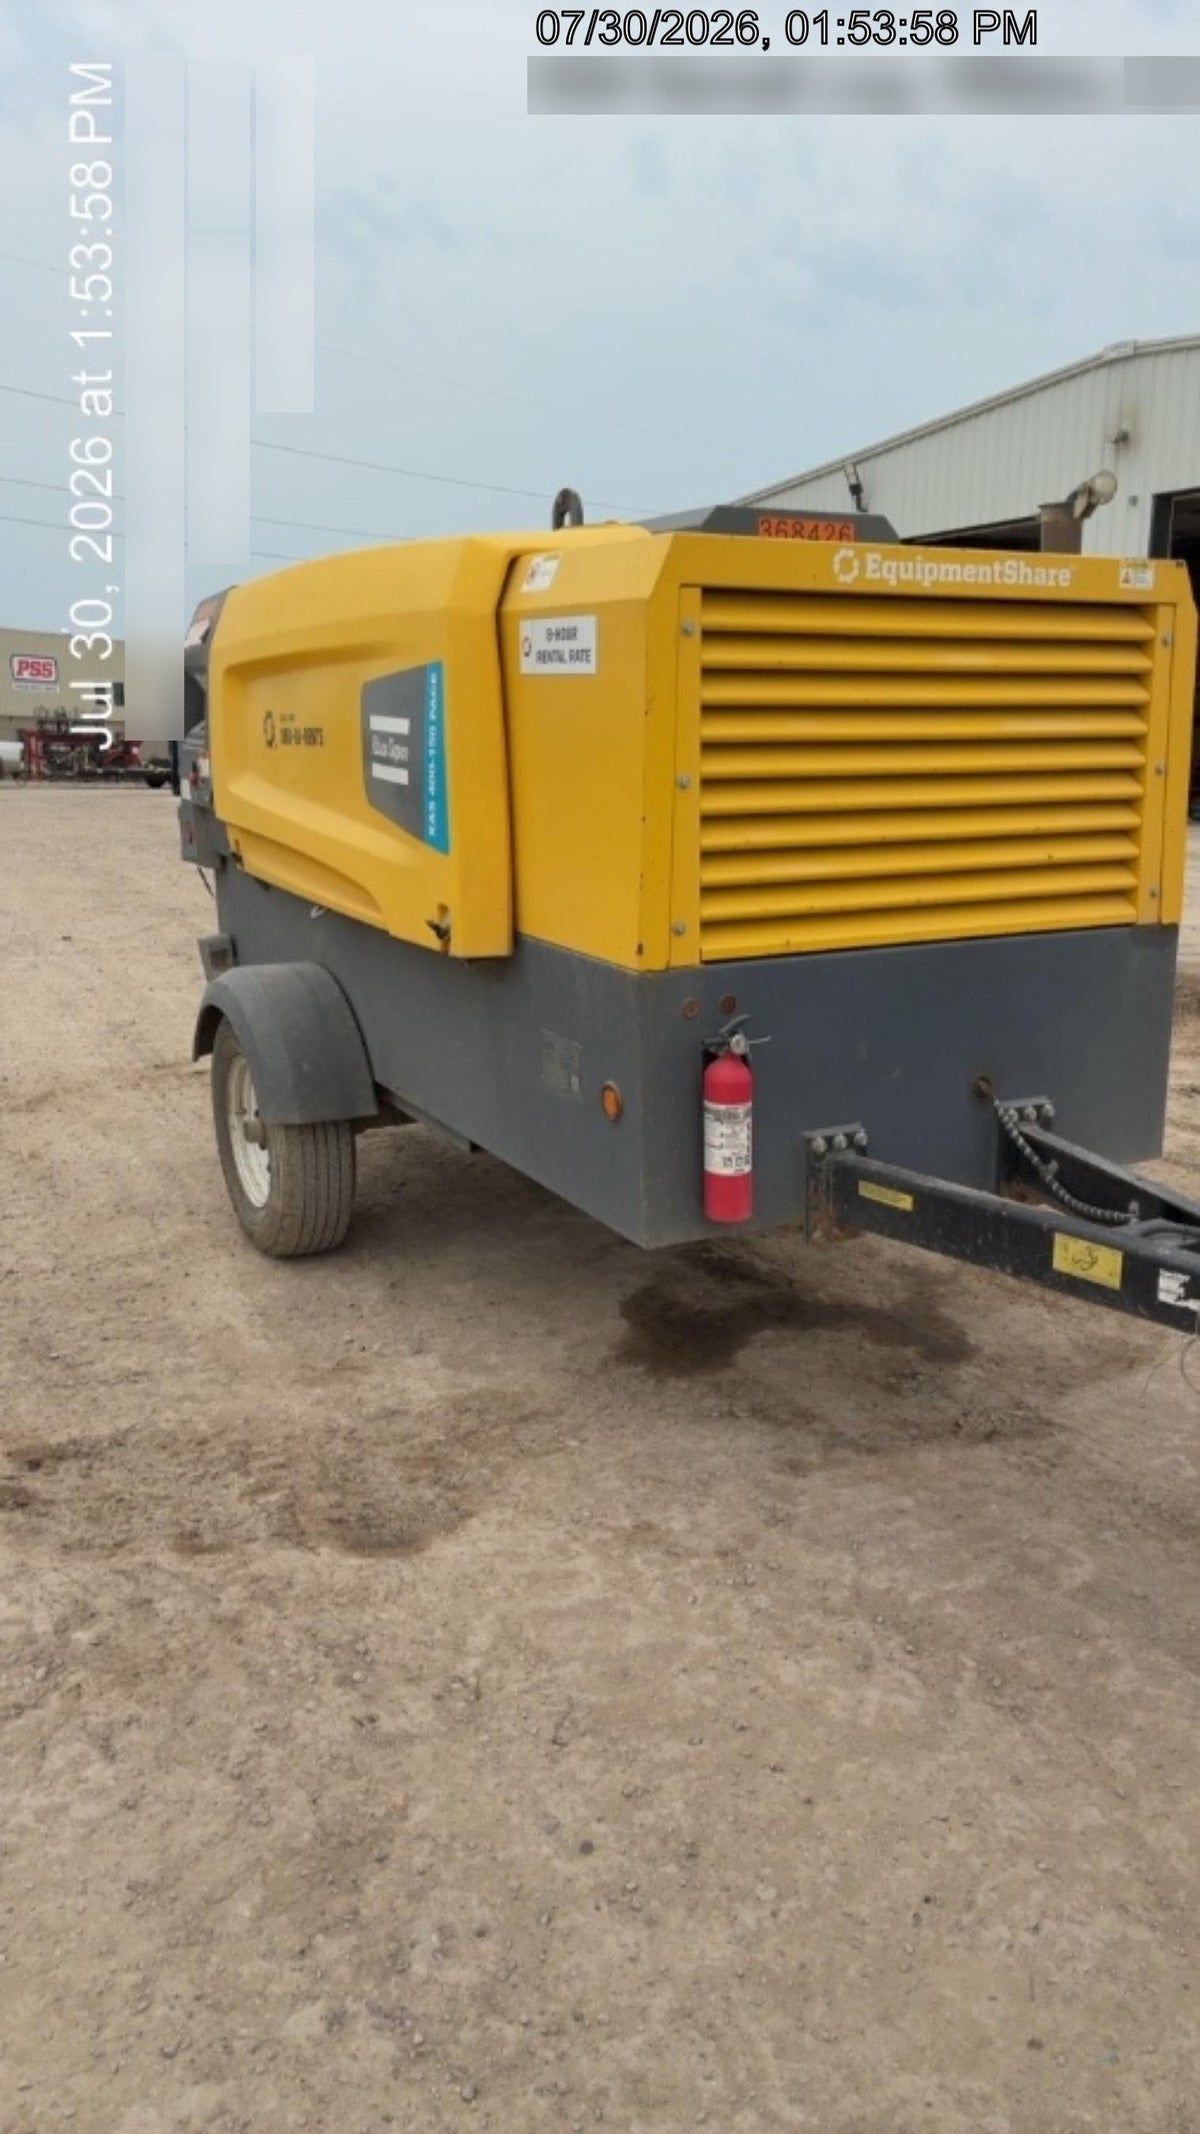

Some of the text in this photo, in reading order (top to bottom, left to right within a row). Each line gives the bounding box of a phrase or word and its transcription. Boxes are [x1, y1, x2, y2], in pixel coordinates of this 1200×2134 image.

[760, 518, 852, 541] 368426
[866, 554, 1072, 587] EquipmentShare
[568, 648, 592, 664] RATE
